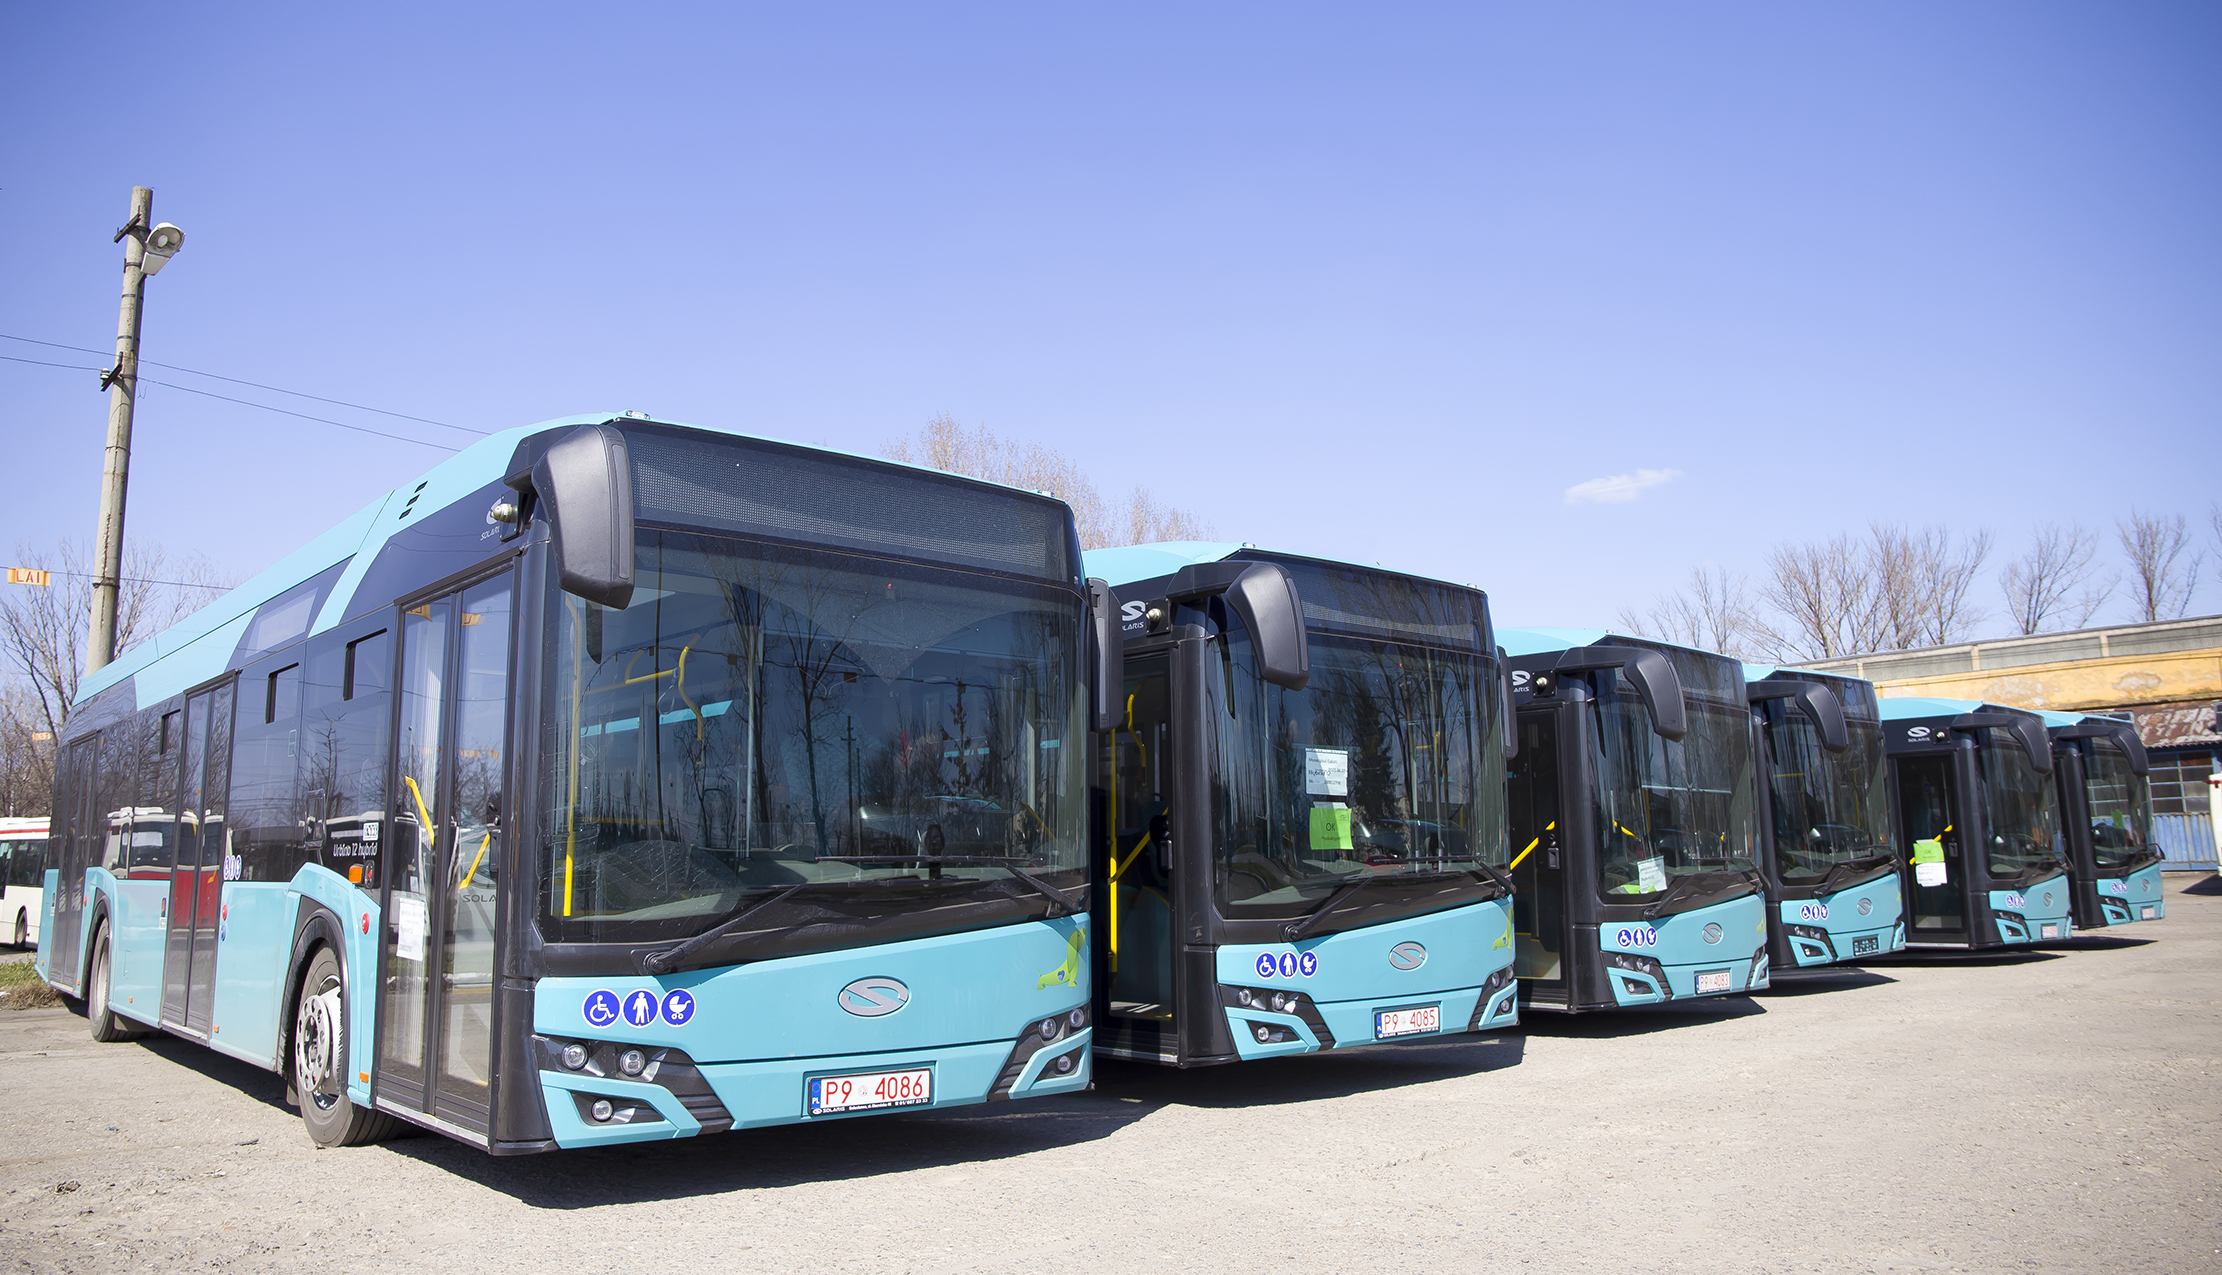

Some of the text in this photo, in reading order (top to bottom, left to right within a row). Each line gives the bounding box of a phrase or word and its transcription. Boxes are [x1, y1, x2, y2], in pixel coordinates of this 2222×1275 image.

[16, 570, 40, 584] LAI
[1122, 621, 1145, 631] LARIS
[1325, 822, 1336, 832] OK
[333, 842, 378, 860] Urbino 12 hybrid
[1384, 1009, 1435, 1031] P9 4085
[826, 1074, 923, 1105] P9 4086
[812, 1097, 820, 1105] PL
